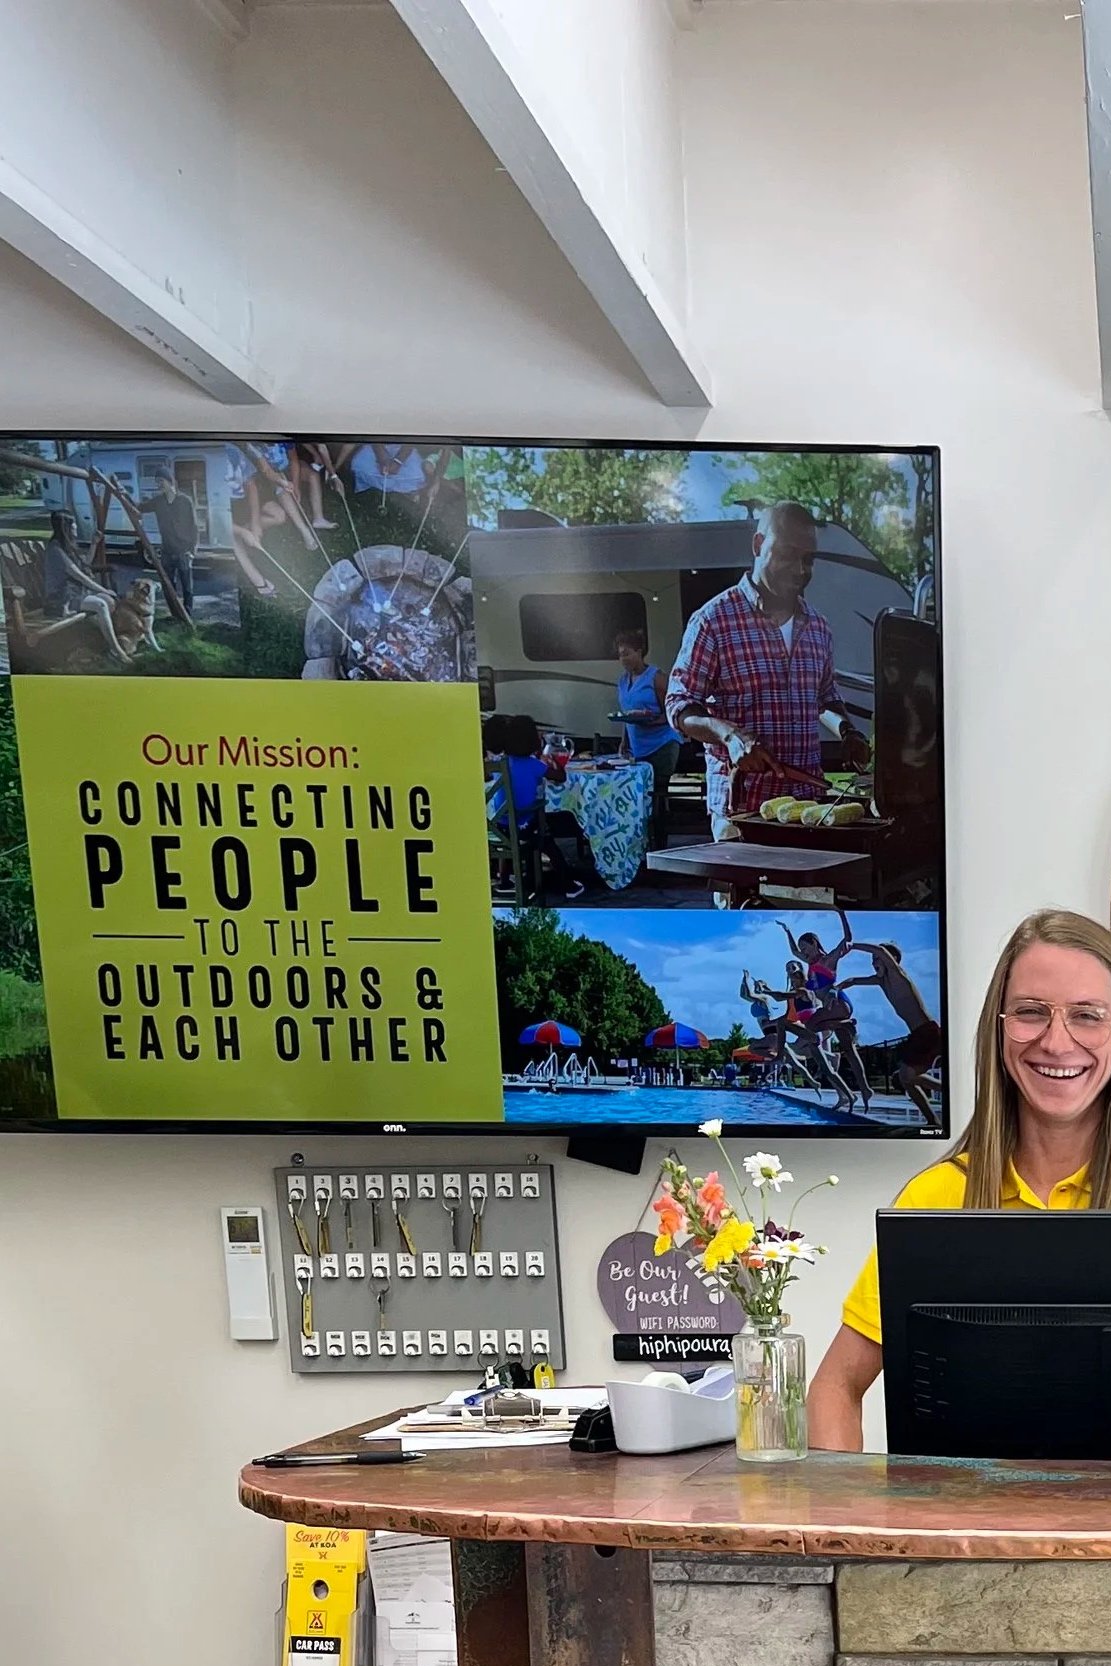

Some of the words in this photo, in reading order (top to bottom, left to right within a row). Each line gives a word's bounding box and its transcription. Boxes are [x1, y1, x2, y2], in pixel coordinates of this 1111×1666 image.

[142, 734, 209, 765] Our
[219, 736, 361, 769] Mission:
[78, 780, 434, 831] CONNECTING
[84, 834, 439, 913] PEOPLE
[193, 918, 239, 956] TO
[264, 919, 337, 957] THE
[98, 963, 382, 1010] OUTDOORS
[416, 967, 444, 1011] &
[102, 1014, 241, 1061] EACH
[275, 1016, 448, 1062] OTHER
[383, 1124, 406, 1132] onn.
[609, 1260, 635, 1280] Be
[639, 1260, 681, 1281] Our
[625, 1283, 689, 1311] Guest!
[640, 1317, 663, 1329] WIFI
[667, 1316, 719, 1329] PASSWORD:
[639, 1335, 735, 1359] hiphipoura
[293, 1530, 321, 1542] Save
[325, 1531, 350, 1542] 10%
[296, 1639, 313, 1651] CAR
[314, 1640, 335, 1651] PASS
